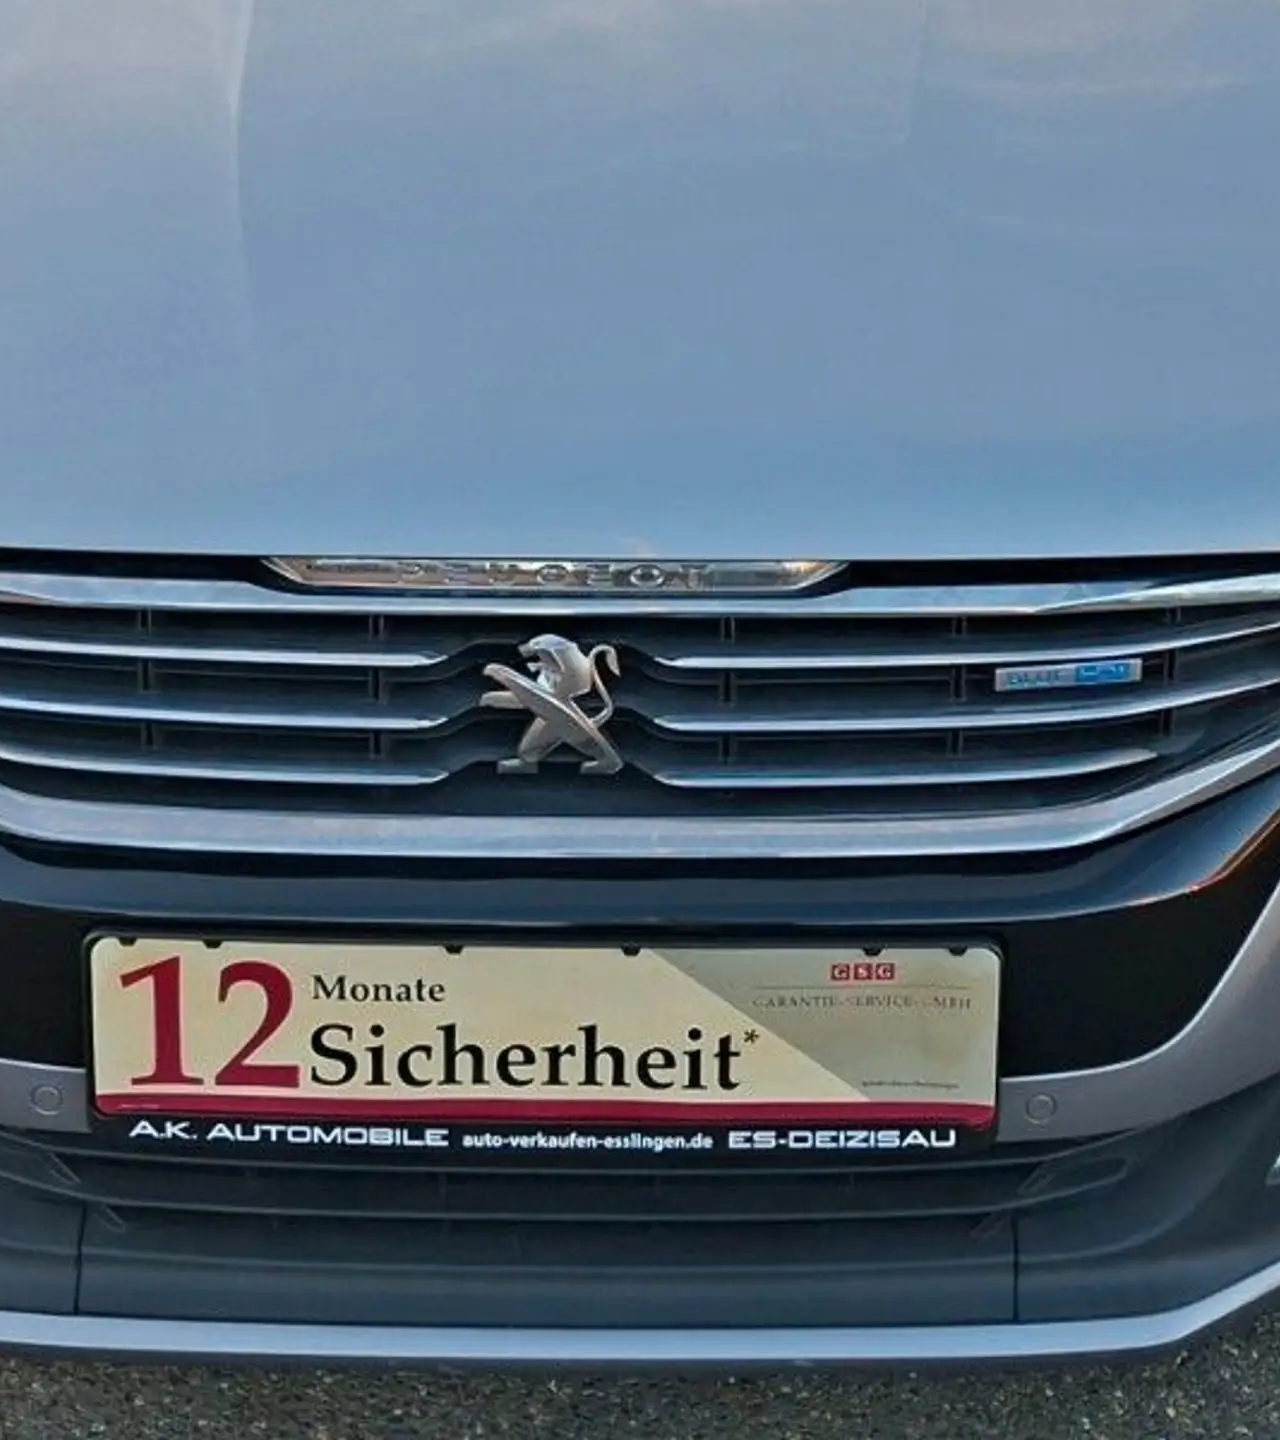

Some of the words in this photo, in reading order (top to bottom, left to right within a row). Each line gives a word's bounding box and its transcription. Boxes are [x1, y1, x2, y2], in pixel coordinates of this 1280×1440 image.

[312, 974, 446, 1003] Monate
[120, 955, 301, 1089] 12
[128, 1119, 198, 1142] A.K.
[206, 1122, 450, 1148] AUTOMOBILE
[462, 1130, 714, 1153] auto-verkaufen-esslingen.de
[727, 1128, 957, 1150] ES-DEIZISAU
